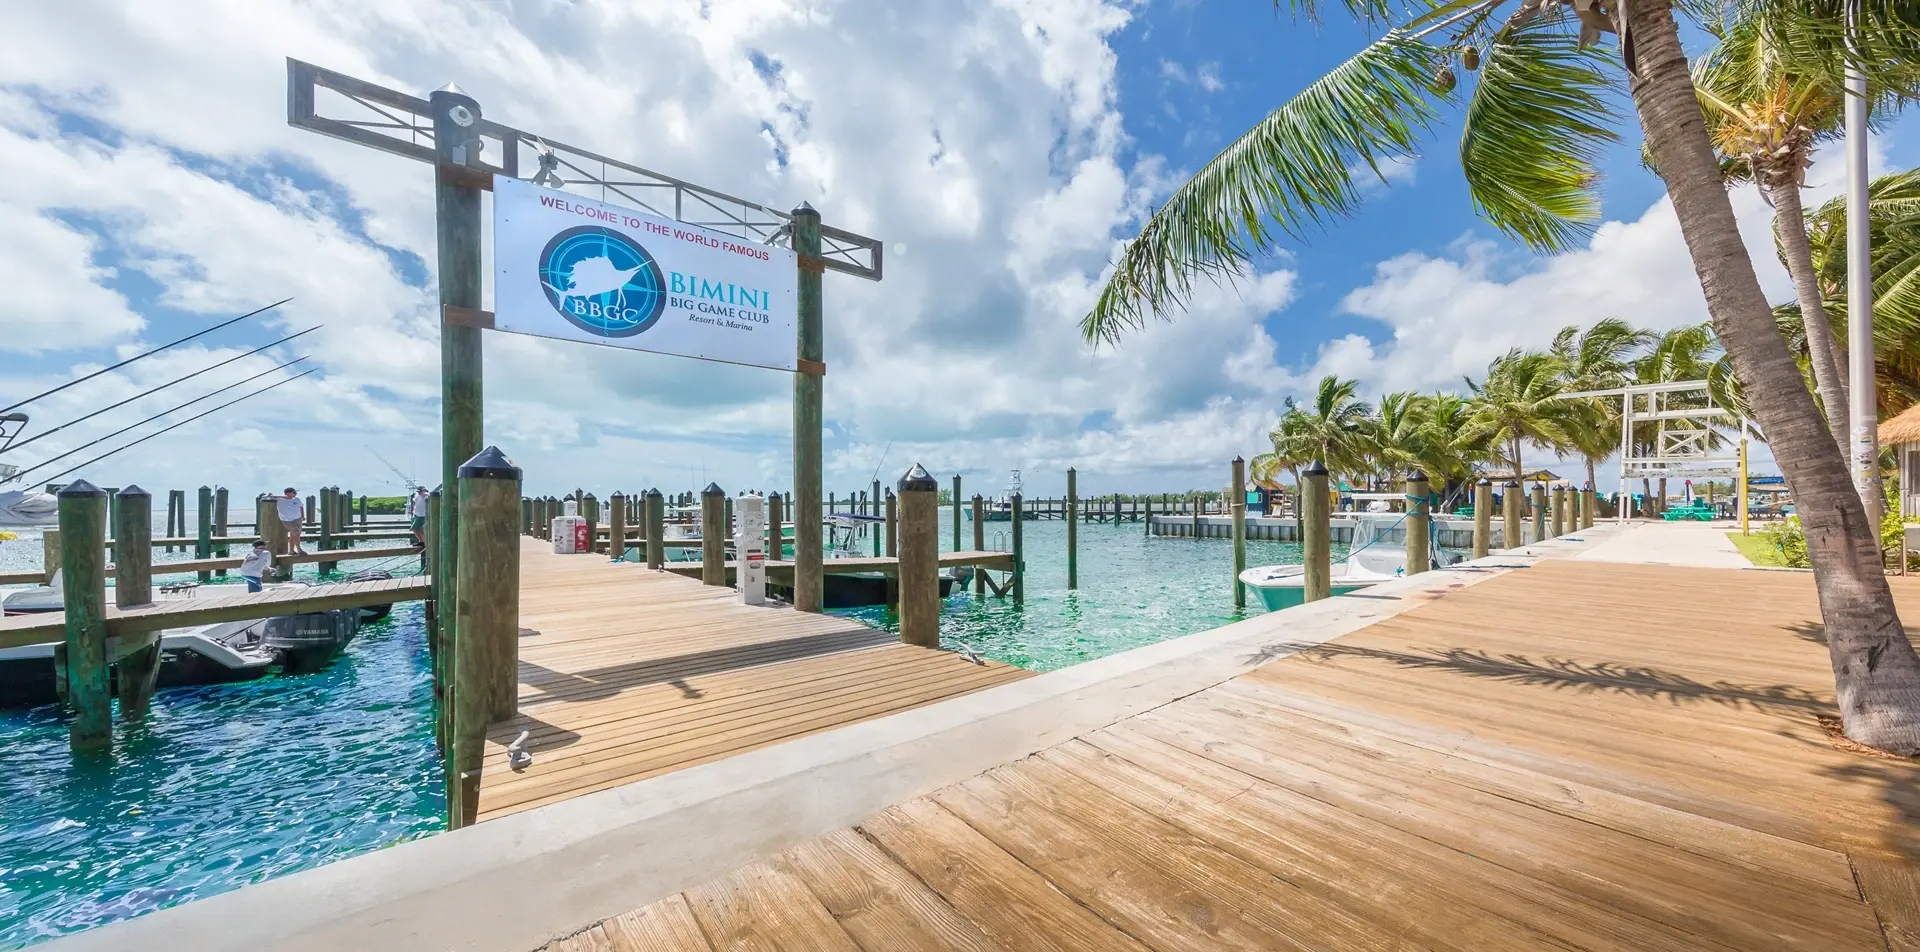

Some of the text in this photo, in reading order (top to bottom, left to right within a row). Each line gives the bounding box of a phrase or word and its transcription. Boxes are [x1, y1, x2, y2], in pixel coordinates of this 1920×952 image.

[540, 195, 769, 261] WELCOME TO THE WORLD FAMOUS
[669, 271, 770, 311] BIMINI
[574, 298, 638, 324] BBGC
[670, 296, 769, 324] BIG GAME CLUB
[689, 313, 753, 331] Resort & Marina
